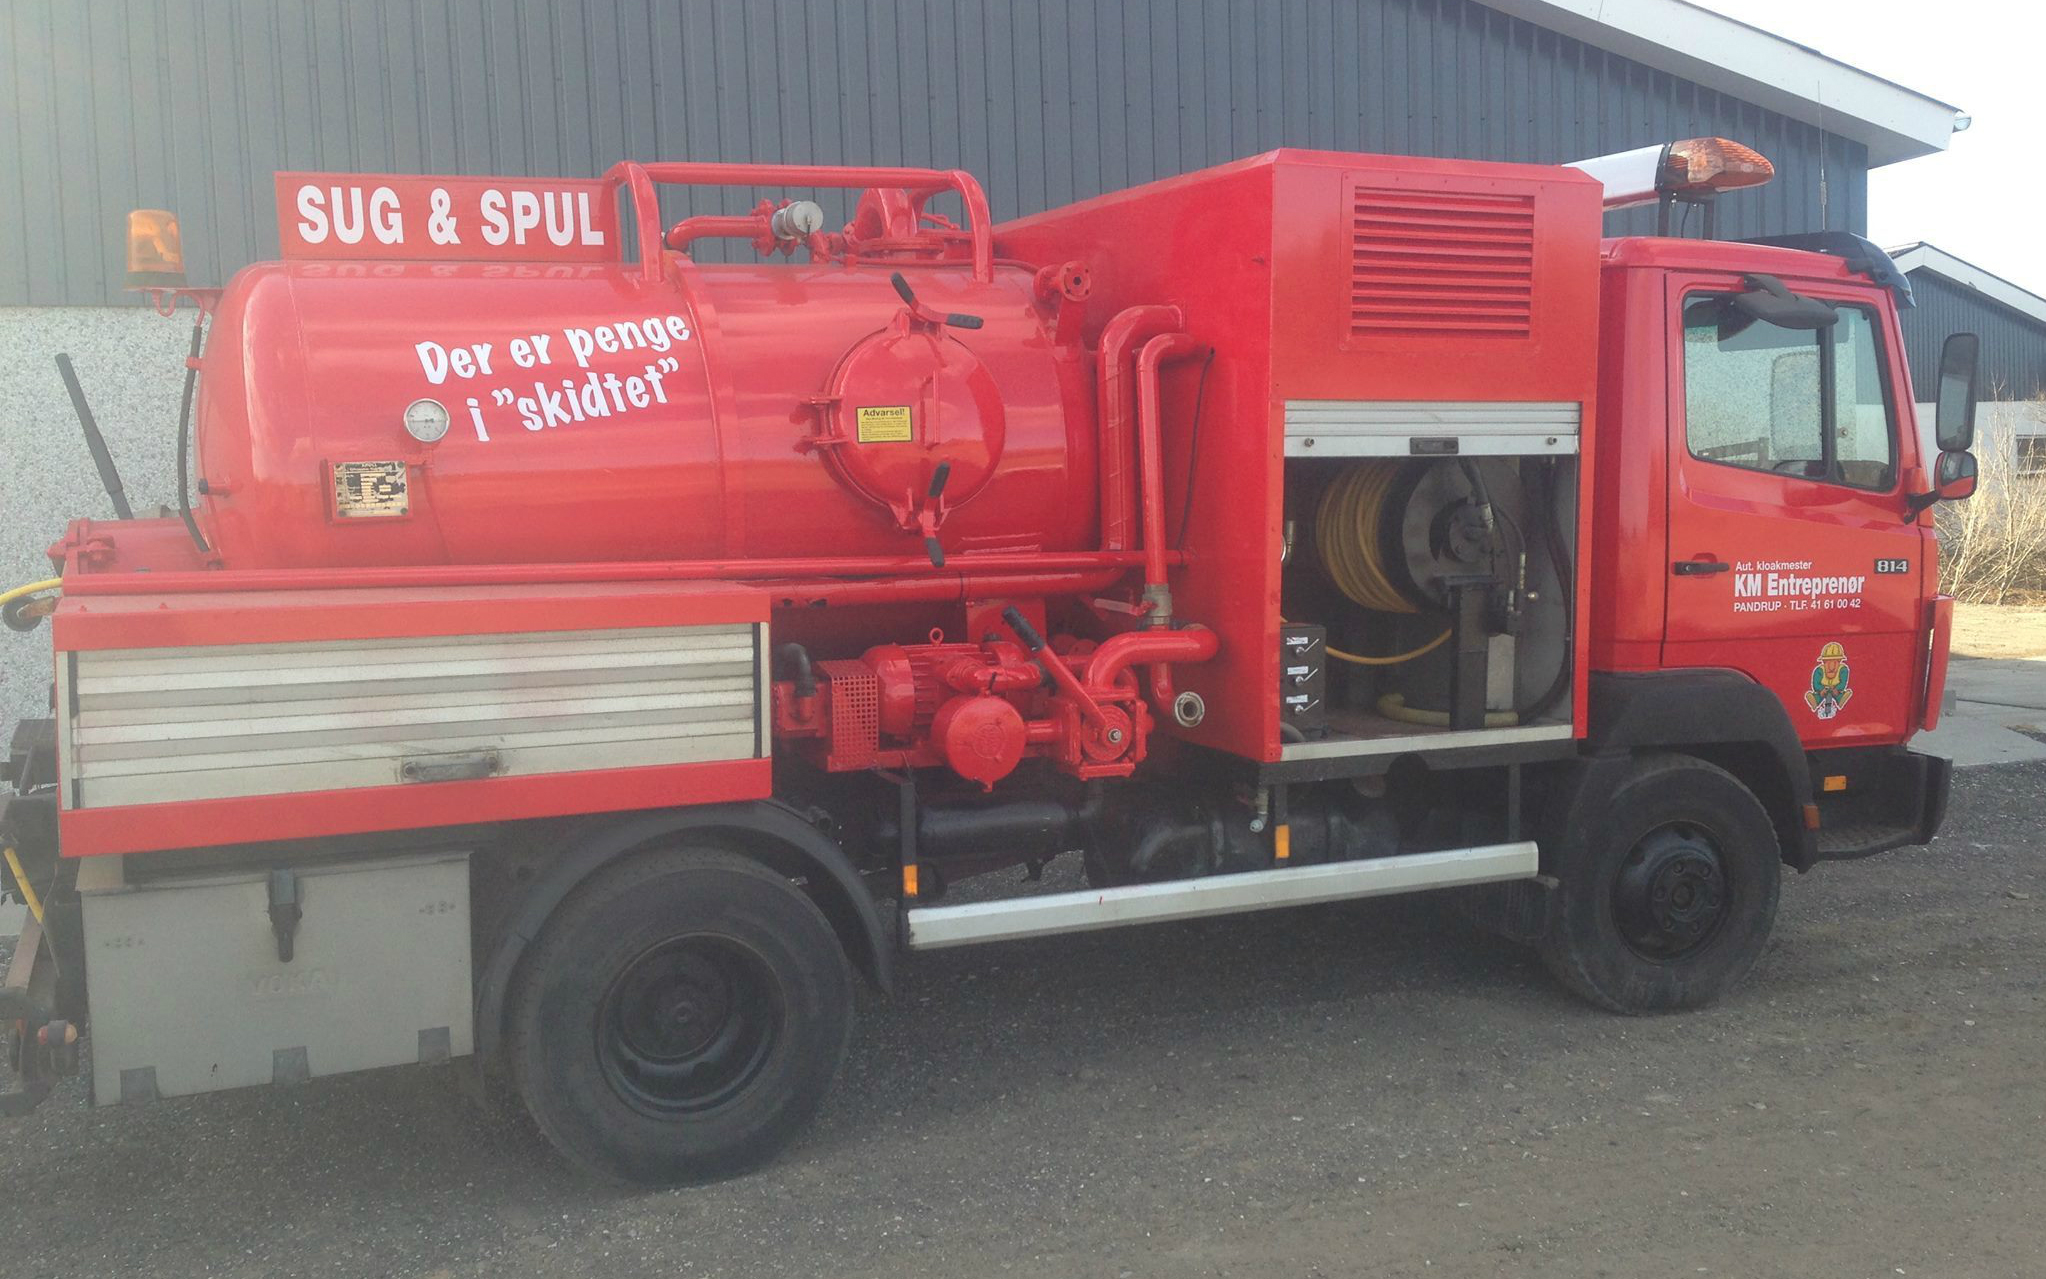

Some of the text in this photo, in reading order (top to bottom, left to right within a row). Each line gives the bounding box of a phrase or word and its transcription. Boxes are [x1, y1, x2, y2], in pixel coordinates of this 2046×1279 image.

[297, 185, 605, 246] SUG & SPUL
[415, 315, 690, 385] Der er penge
[466, 397, 490, 442] i
[863, 408, 905, 417] Advarsel!
[1735, 560, 1813, 571] Aut. kloakmester
[1877, 560, 1908, 573] 814
[1734, 572, 1865, 599] KM Entreprenør
[1733, 601, 1782, 612] PANDRUP
[1790, 600, 1808, 611] TLF.
[1811, 599, 1821, 610] 41
[1824, 599, 1834, 609] 61
[1837, 598, 1848, 609] 00
[1849, 598, 1861, 608] 42
